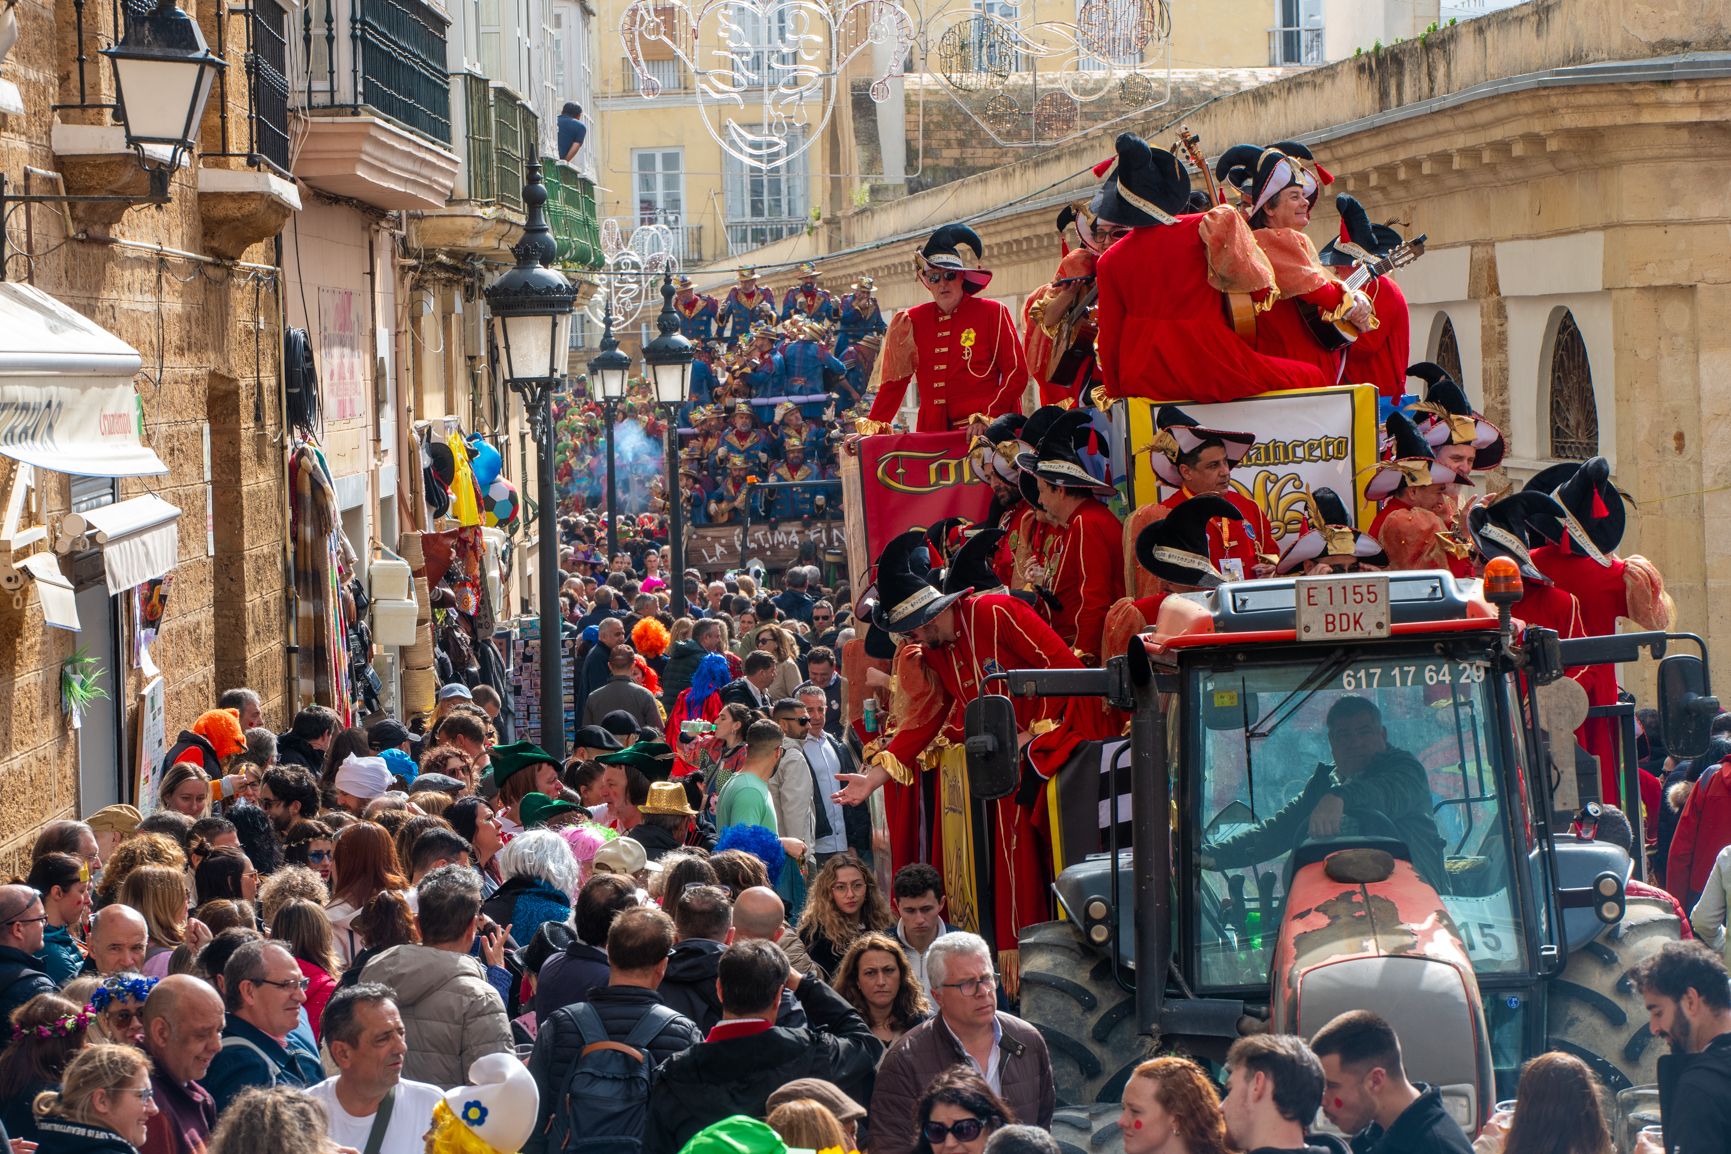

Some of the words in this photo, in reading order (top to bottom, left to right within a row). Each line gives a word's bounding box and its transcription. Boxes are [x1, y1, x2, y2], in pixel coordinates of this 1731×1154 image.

[702, 543, 728, 564] LA
[1307, 587, 1318, 606] E
[1327, 584, 1378, 605] 1155
[1325, 612, 1365, 633] BDK
[1343, 668, 1381, 690] 617
[1391, 666, 1416, 688] 17
[1424, 664, 1452, 685] 64
[1458, 663, 1486, 684] 29
